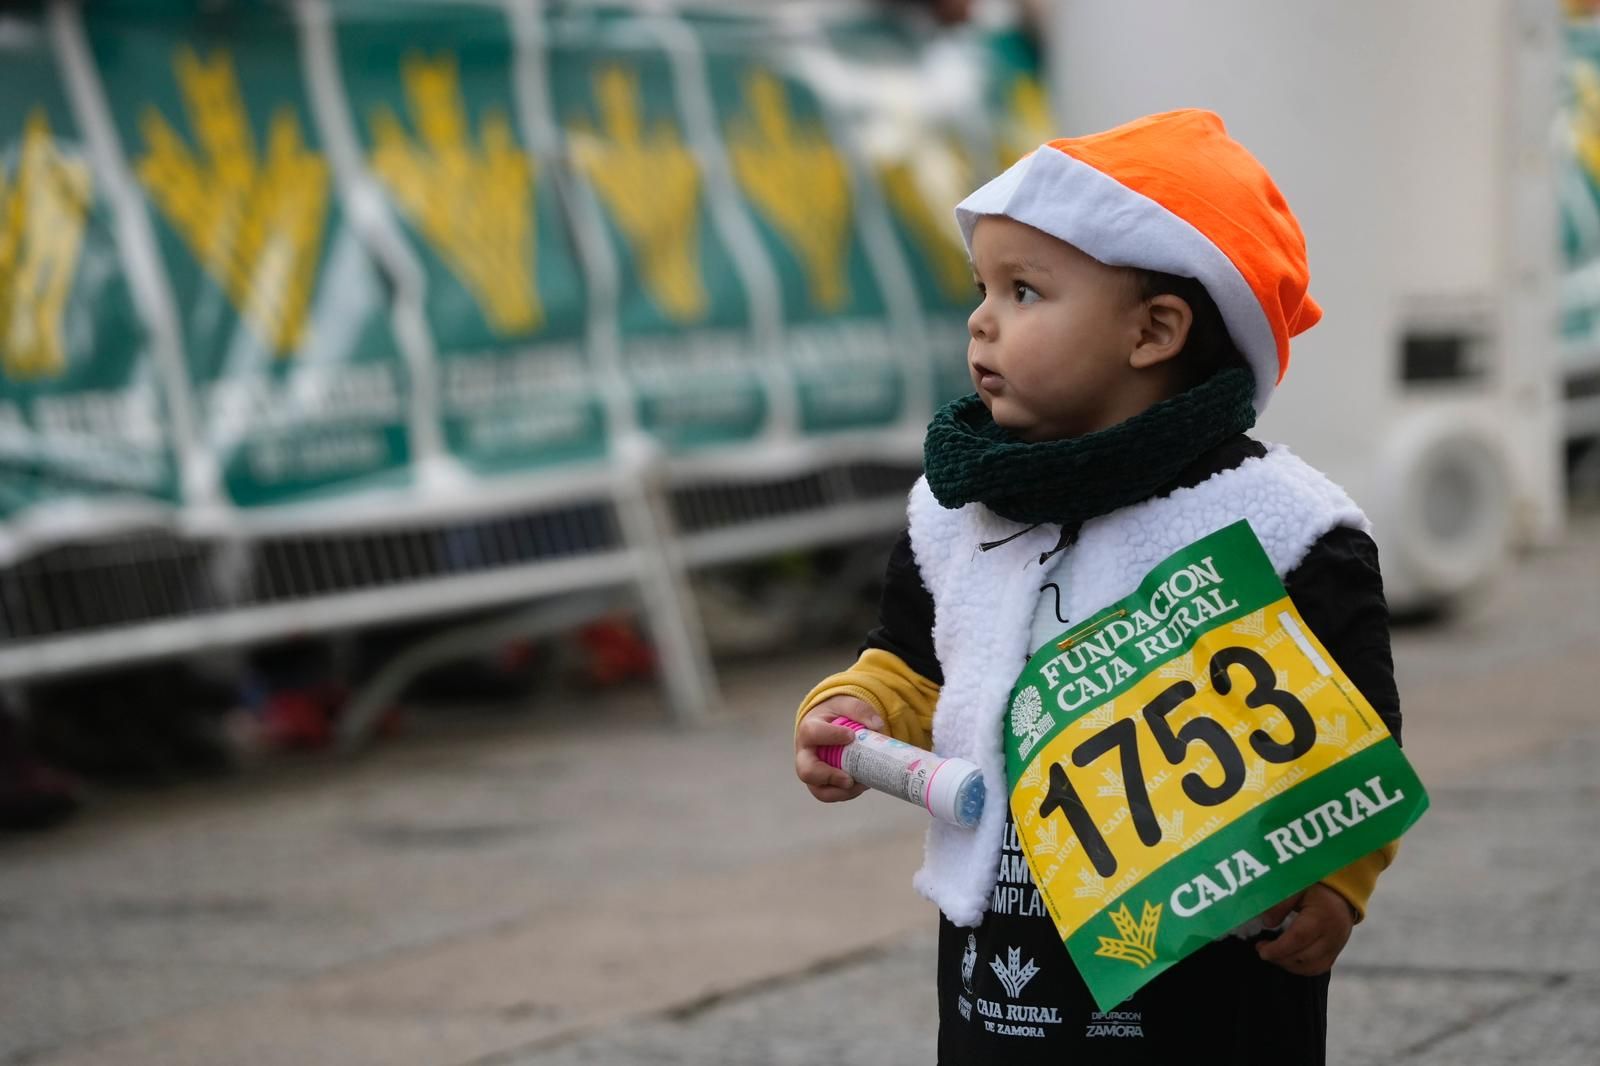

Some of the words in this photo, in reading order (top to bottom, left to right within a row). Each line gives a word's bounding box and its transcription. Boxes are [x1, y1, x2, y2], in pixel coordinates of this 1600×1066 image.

[1040, 556, 1224, 690] FUNDACION
[1056, 656, 1138, 712] CAJA
[1134, 588, 1240, 663] RURAL
[1038, 645, 1317, 878] 1753
[997, 854, 1036, 885] AM
[1170, 849, 1271, 918] CAJA
[1264, 775, 1405, 864] RURAL
[976, 998, 1004, 1020] CAJA
[1005, 1003, 1063, 1024] RURAL
[984, 1020, 996, 1033] DE
[997, 1023, 1046, 1038] ZAMORA
[1085, 1025, 1145, 1038] ZAMORA
